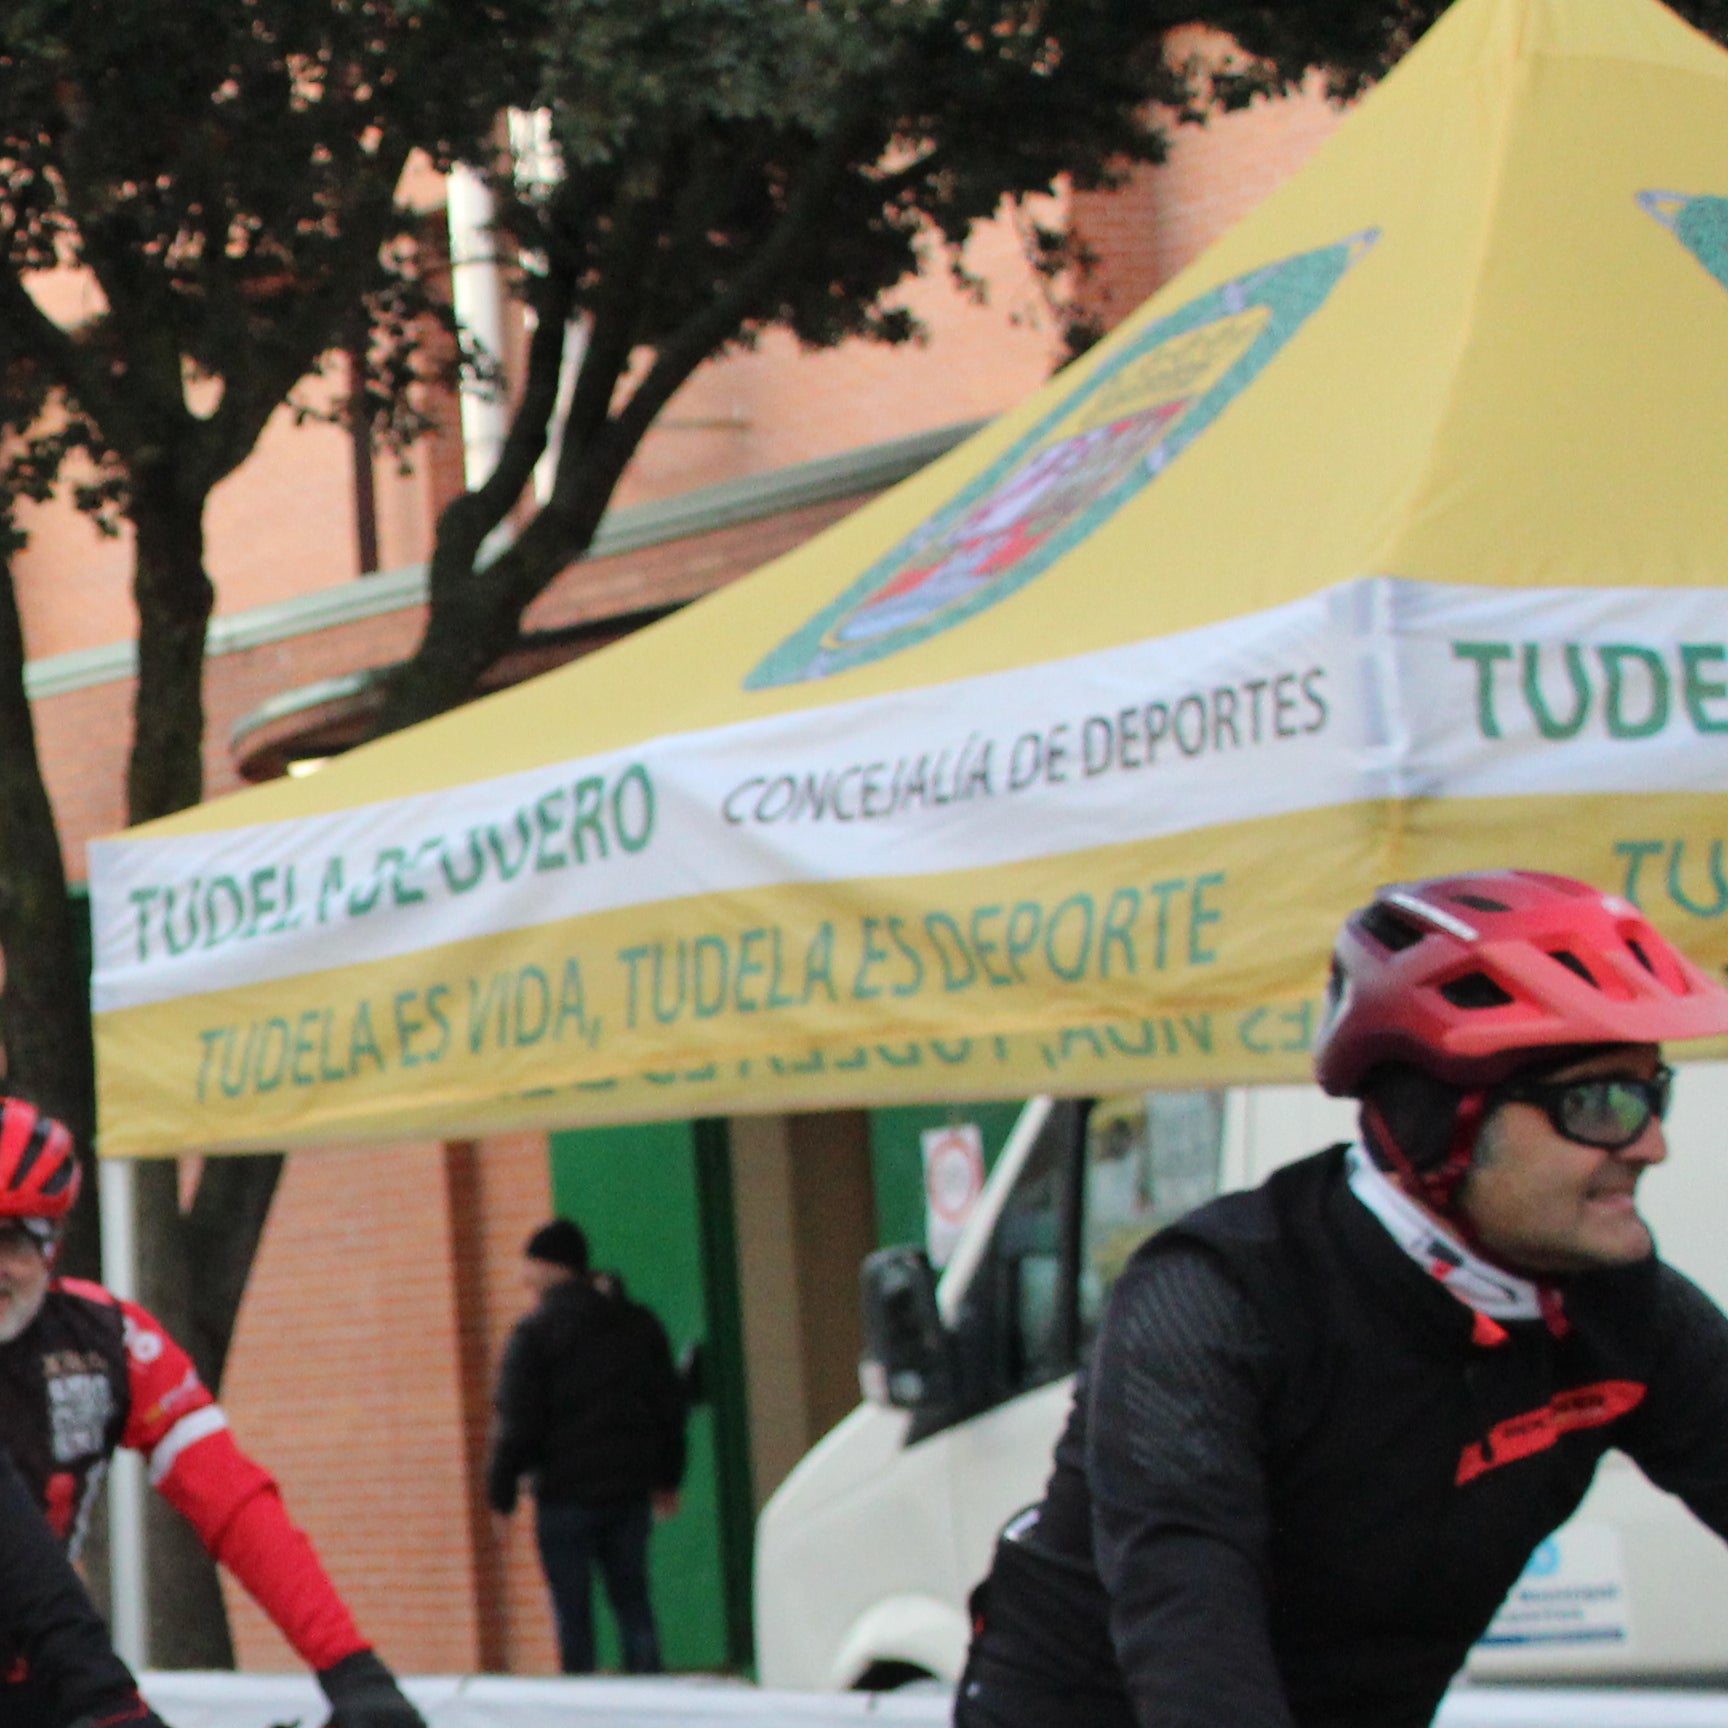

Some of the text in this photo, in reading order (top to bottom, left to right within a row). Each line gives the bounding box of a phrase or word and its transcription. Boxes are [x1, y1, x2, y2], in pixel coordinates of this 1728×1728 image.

[723, 667, 1332, 825] CONCEJALÍA DE DEPORTES
[194, 871, 1227, 1104] TUDELA ES VIDA, TUDELA ES DEPORTE
